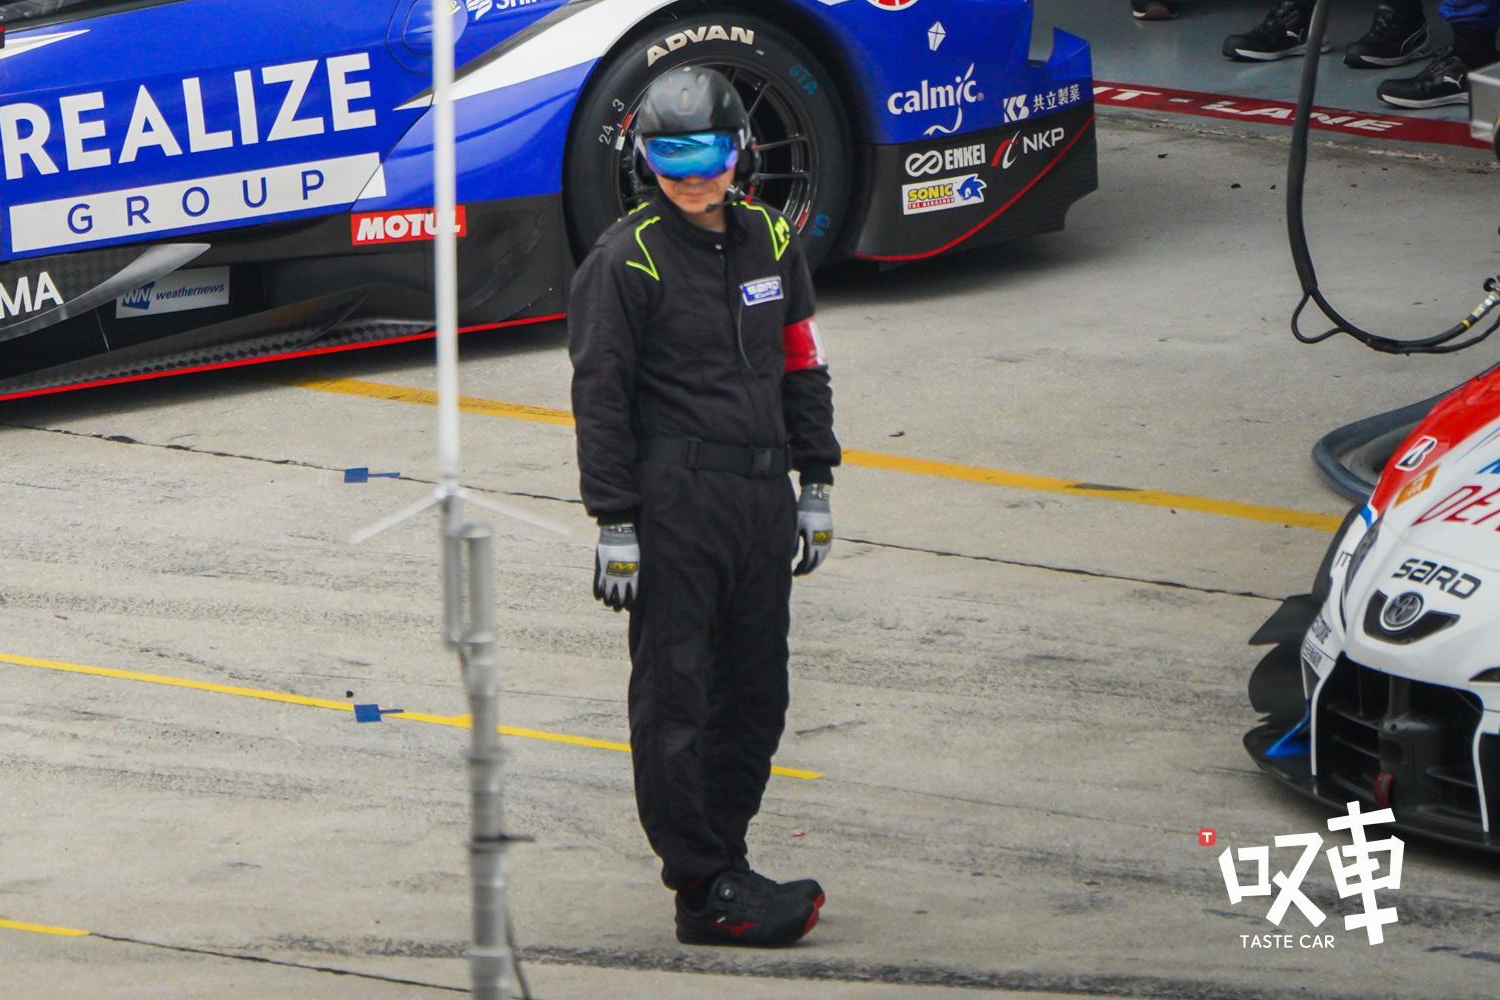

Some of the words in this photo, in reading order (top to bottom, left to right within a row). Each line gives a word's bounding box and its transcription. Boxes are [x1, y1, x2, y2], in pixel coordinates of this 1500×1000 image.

[647, 24, 755, 67] ADVAN
[613, 98, 625, 113] 3
[887, 62, 978, 121] calmic
[1032, 83, 1081, 113] 共立製薬
[1200, 99, 1403, 132] LANE
[598, 123, 614, 146] 24
[1022, 126, 1066, 155] NKP
[944, 143, 986, 171] ENKEI
[67, 168, 325, 235] GROUP
[907, 182, 955, 203] SONIC
[156, 283, 225, 301] weathernews
